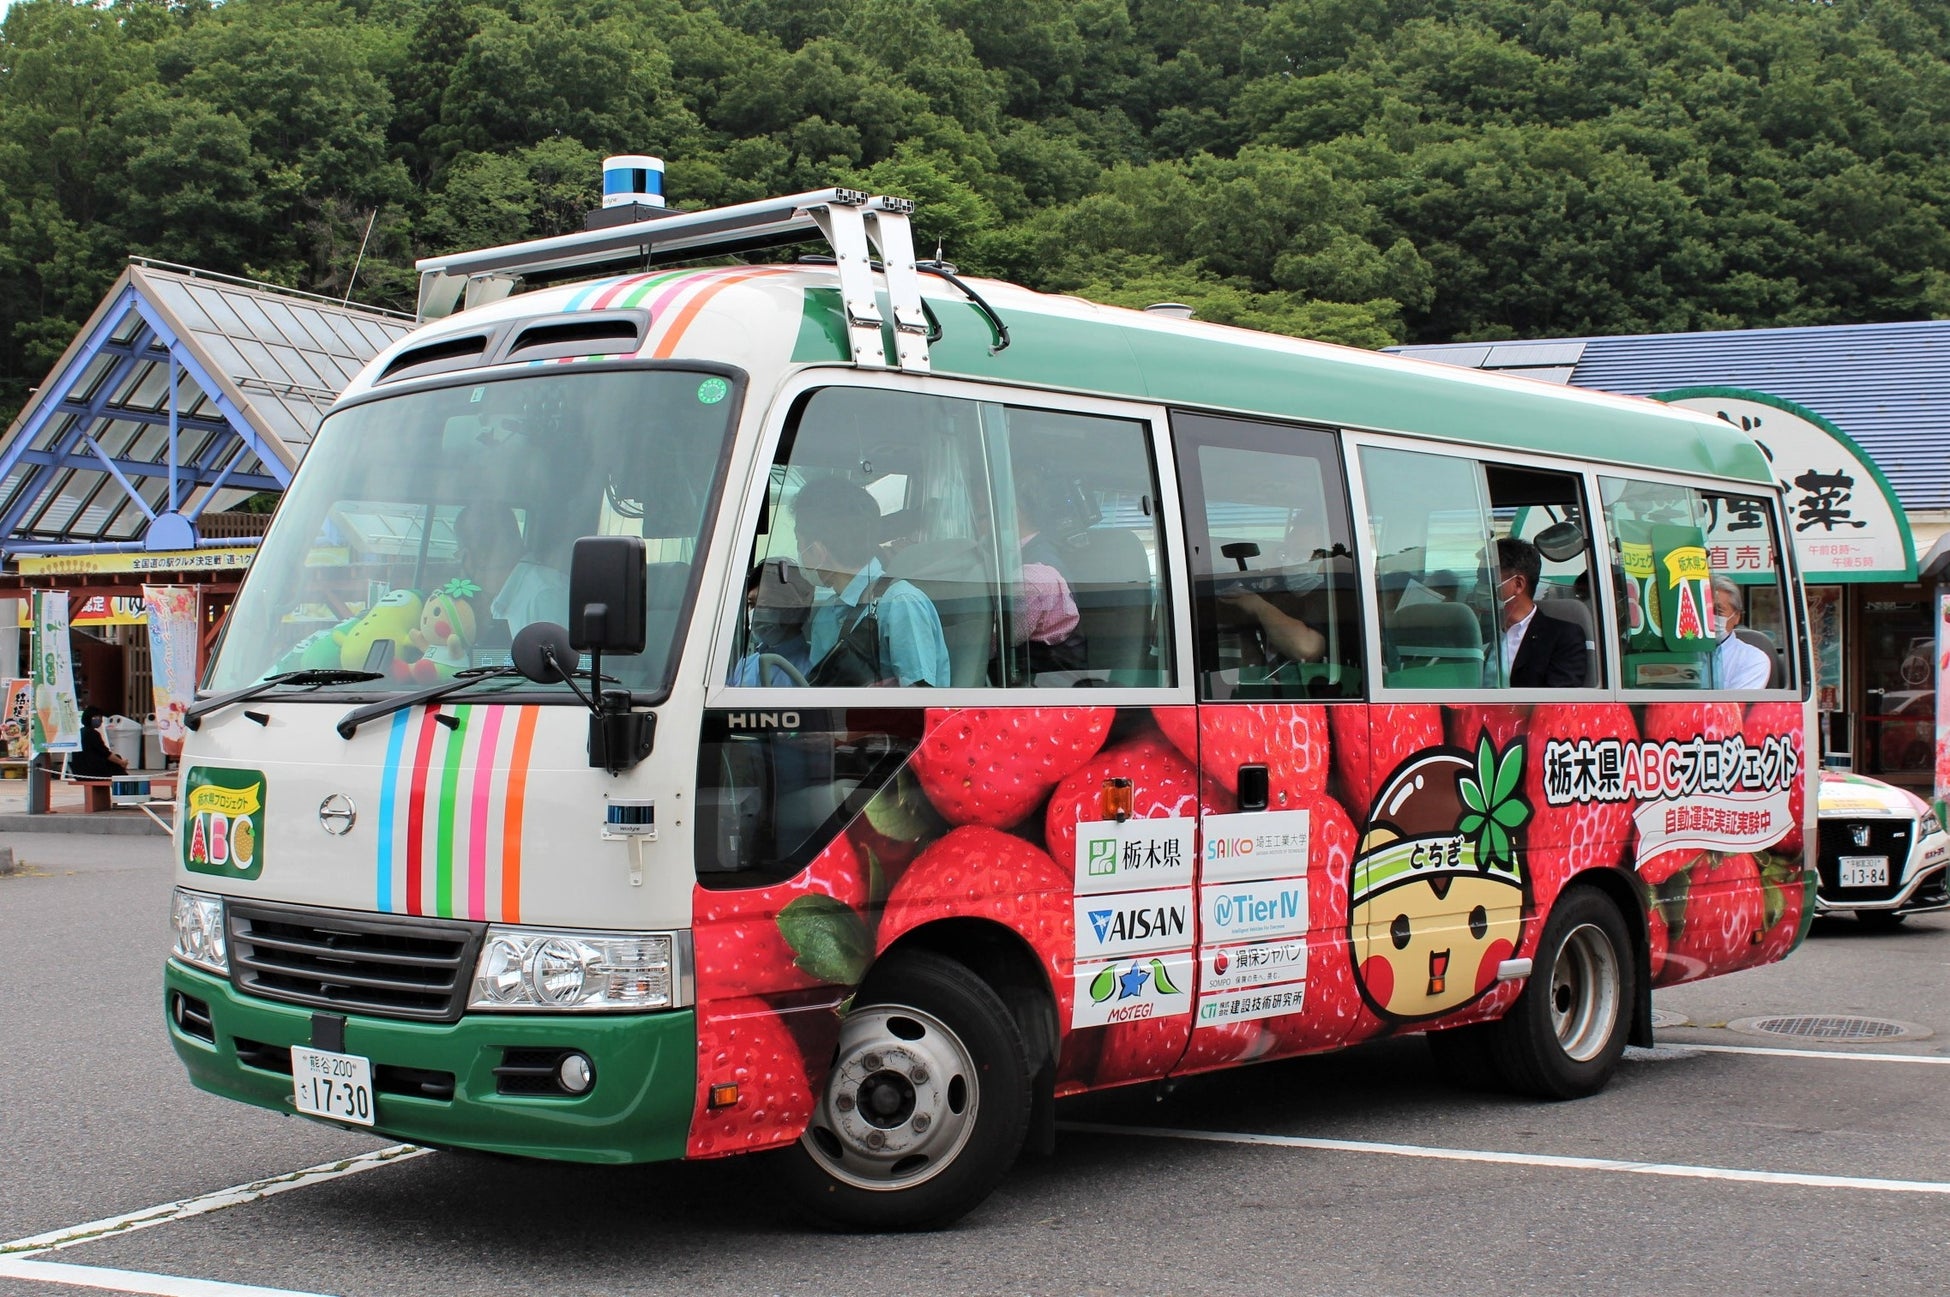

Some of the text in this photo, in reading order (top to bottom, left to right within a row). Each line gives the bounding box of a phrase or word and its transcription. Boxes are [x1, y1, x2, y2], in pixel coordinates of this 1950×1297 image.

[728, 712, 801, 728] HINO
[1545, 736, 1799, 804] 栃木県ABCプロジェクト
[1664, 806, 1771, 835] 自動運転実証実験中
[189, 811, 255, 870] ABC
[1207, 838, 1254, 860] SAIKO
[1256, 833, 1307, 849] 埼玉工業大学
[1409, 830, 1464, 870] とちぎ
[1122, 838, 1181, 871] 栃木県
[1851, 868, 1885, 884] 13-84
[1233, 894, 1278, 924] Tier
[1109, 905, 1185, 942] AISAN
[1235, 944, 1301, 969] 損保ジャパン
[1209, 978, 1232, 989] SOMPO
[1107, 1002, 1154, 1023] MOTEGI
[1230, 990, 1303, 1014] 建設技術研究所
[313, 1077, 368, 1119] 17-30
